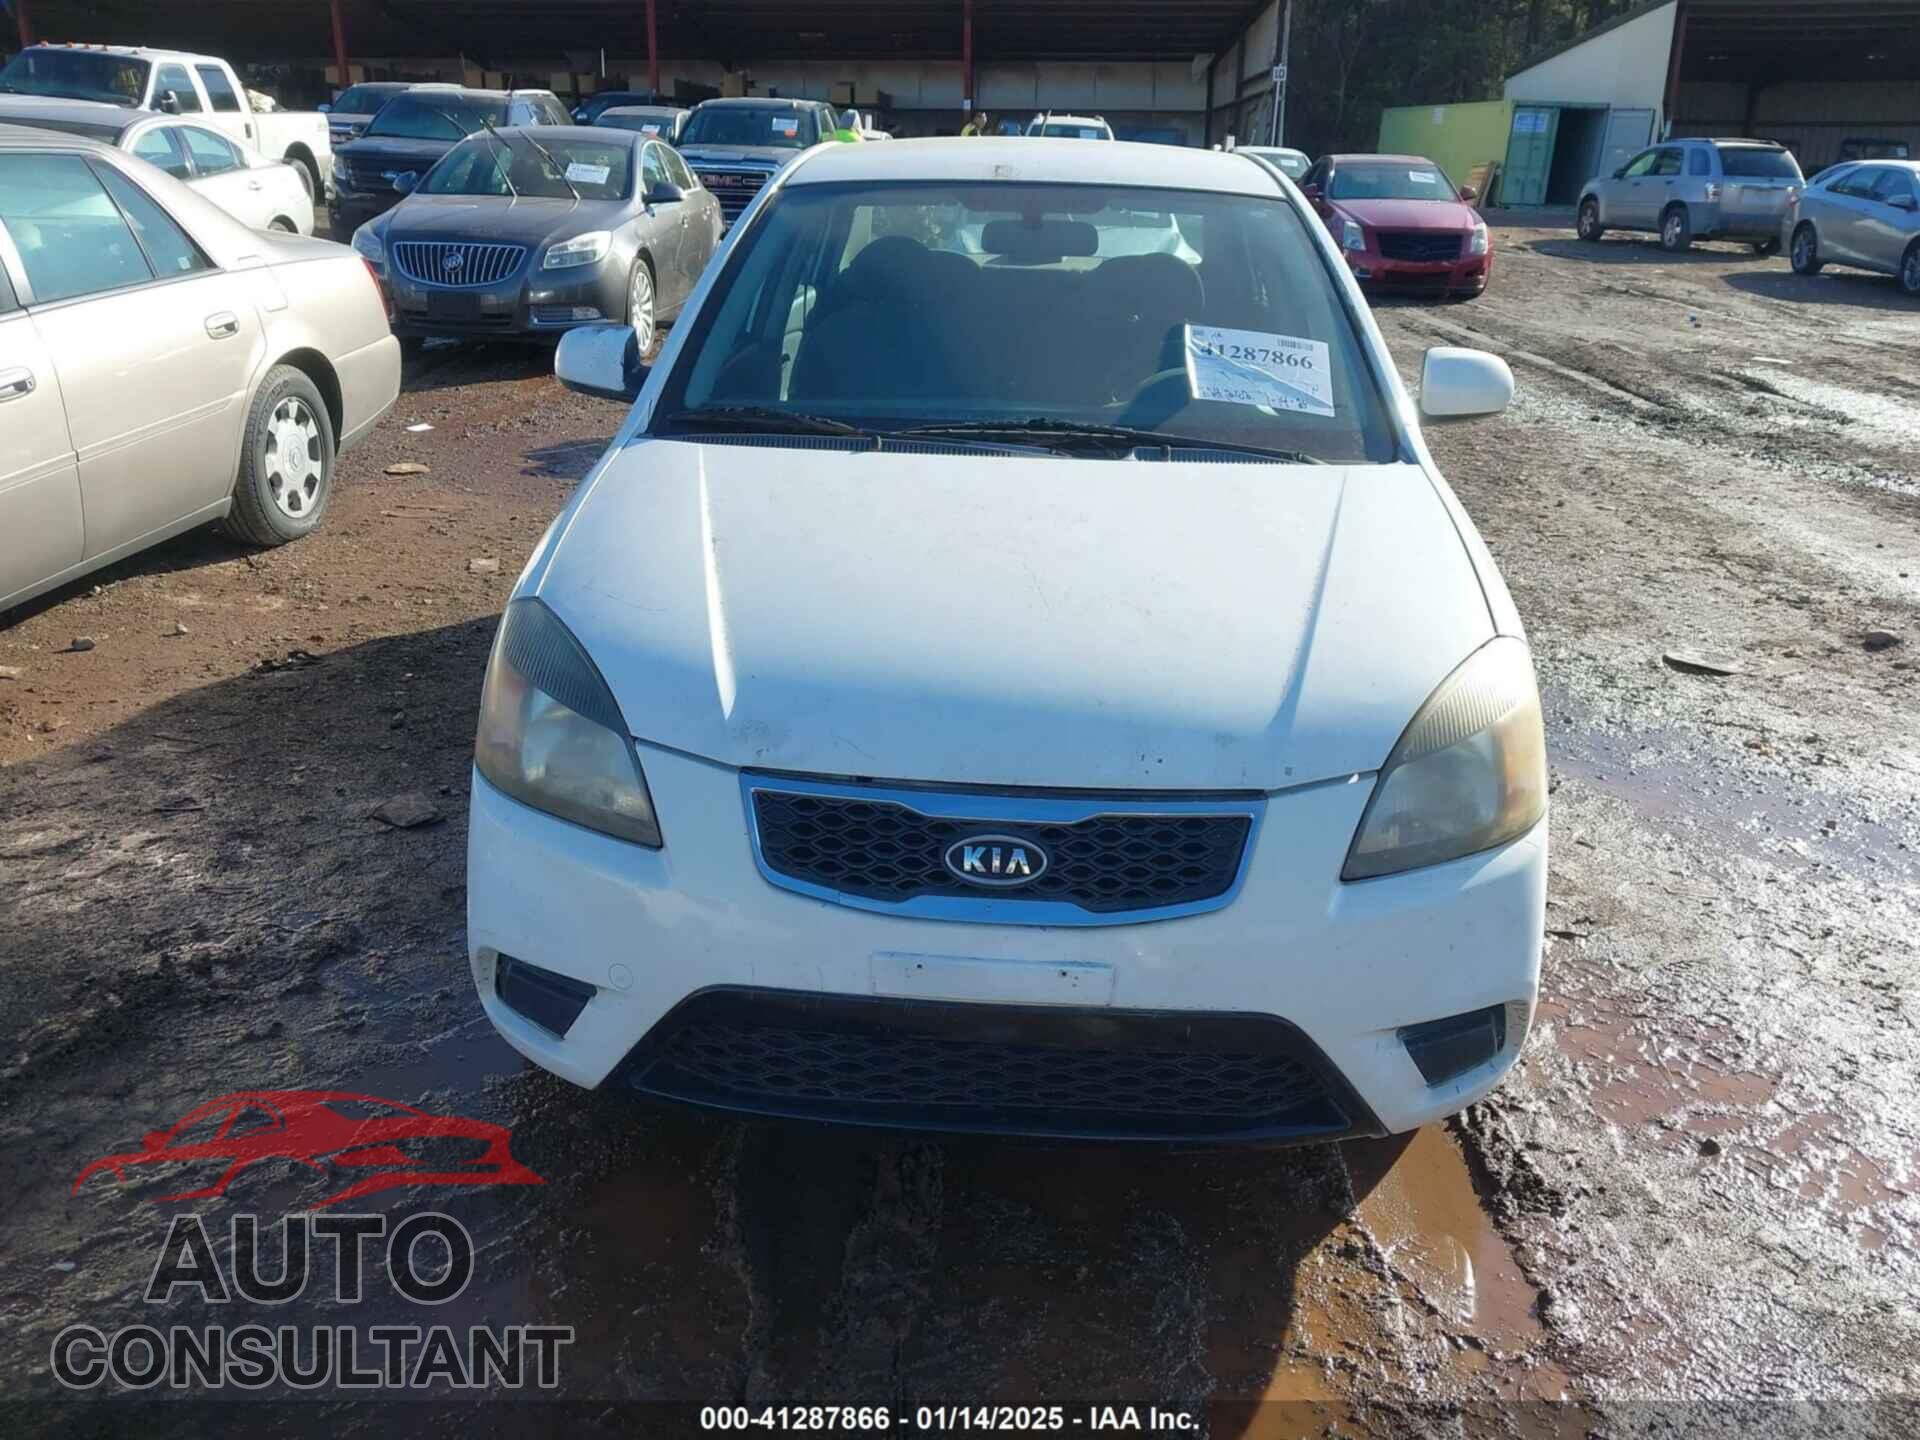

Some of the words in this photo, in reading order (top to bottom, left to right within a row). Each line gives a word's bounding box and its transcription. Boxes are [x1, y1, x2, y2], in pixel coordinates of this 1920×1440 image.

[701, 174, 742, 187] GMC
[1200, 341, 1313, 370] 41287866
[963, 846, 1031, 875] KIA
